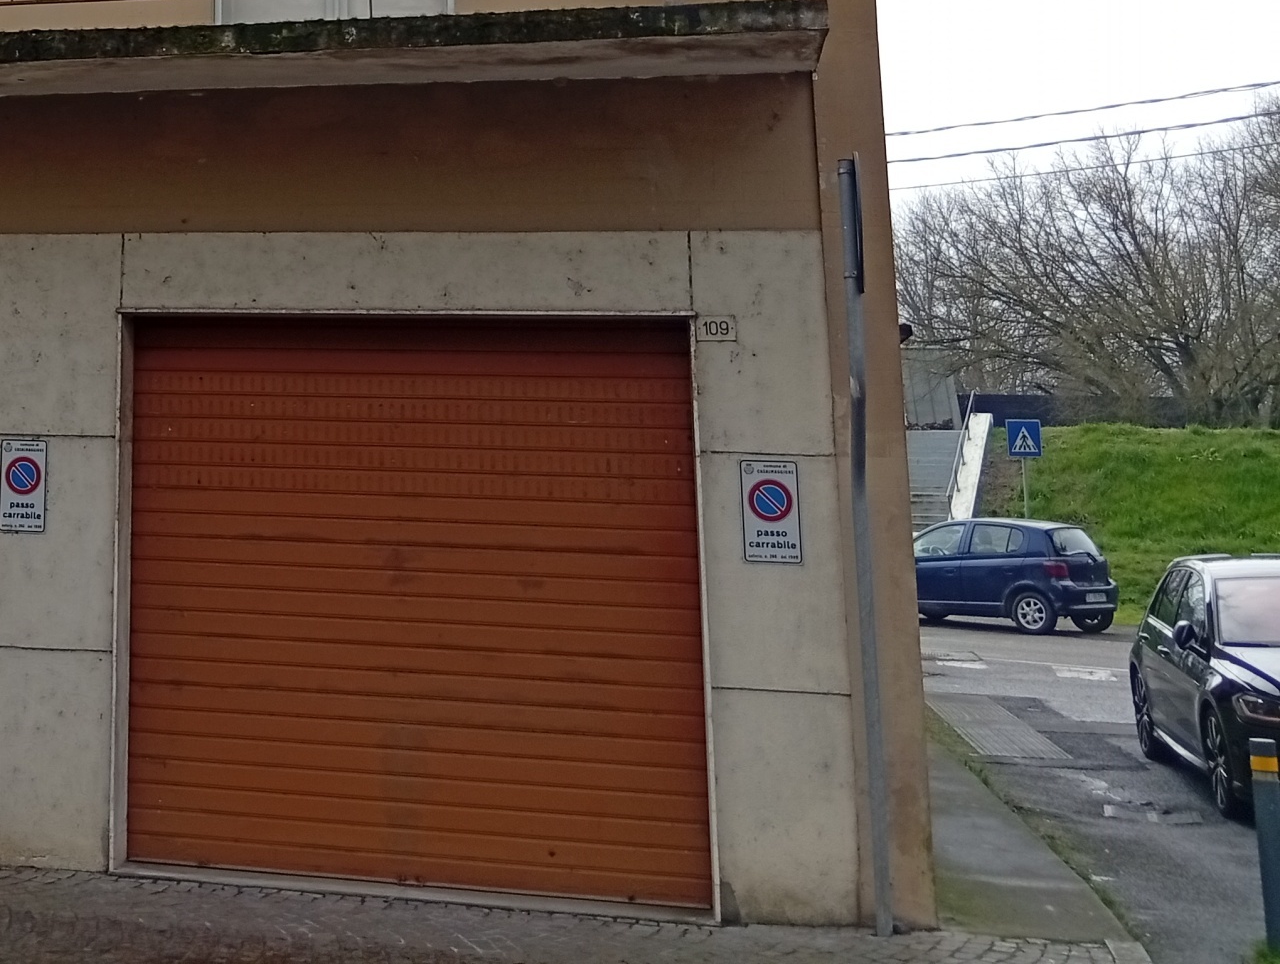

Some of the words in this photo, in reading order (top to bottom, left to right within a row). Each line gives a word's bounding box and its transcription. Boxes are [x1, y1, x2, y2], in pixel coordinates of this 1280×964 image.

[702, 320, 730, 336] 109
[9, 501, 35, 510] passo
[2, 511, 42, 520] carrabile
[756, 529, 788, 538] passo
[748, 540, 797, 550] carrabile
